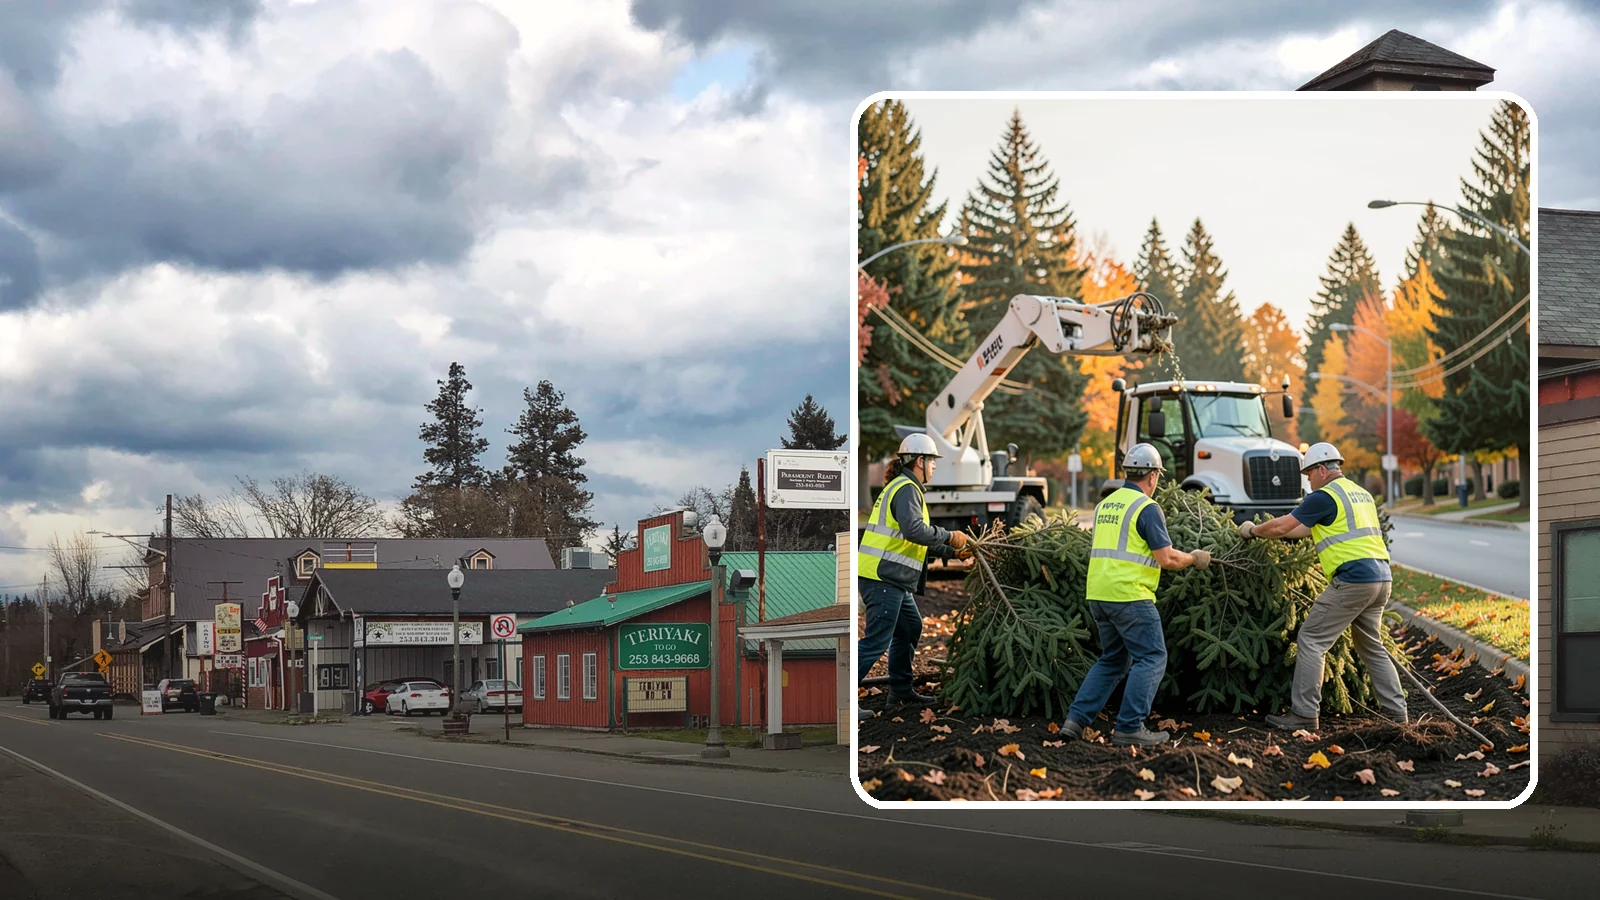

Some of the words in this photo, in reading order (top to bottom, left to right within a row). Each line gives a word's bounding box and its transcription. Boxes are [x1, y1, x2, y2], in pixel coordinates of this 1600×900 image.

[625, 627, 702, 646] TERIYAKI
[629, 654, 648, 664] 253
[652, 654, 700, 664] 843-9668
